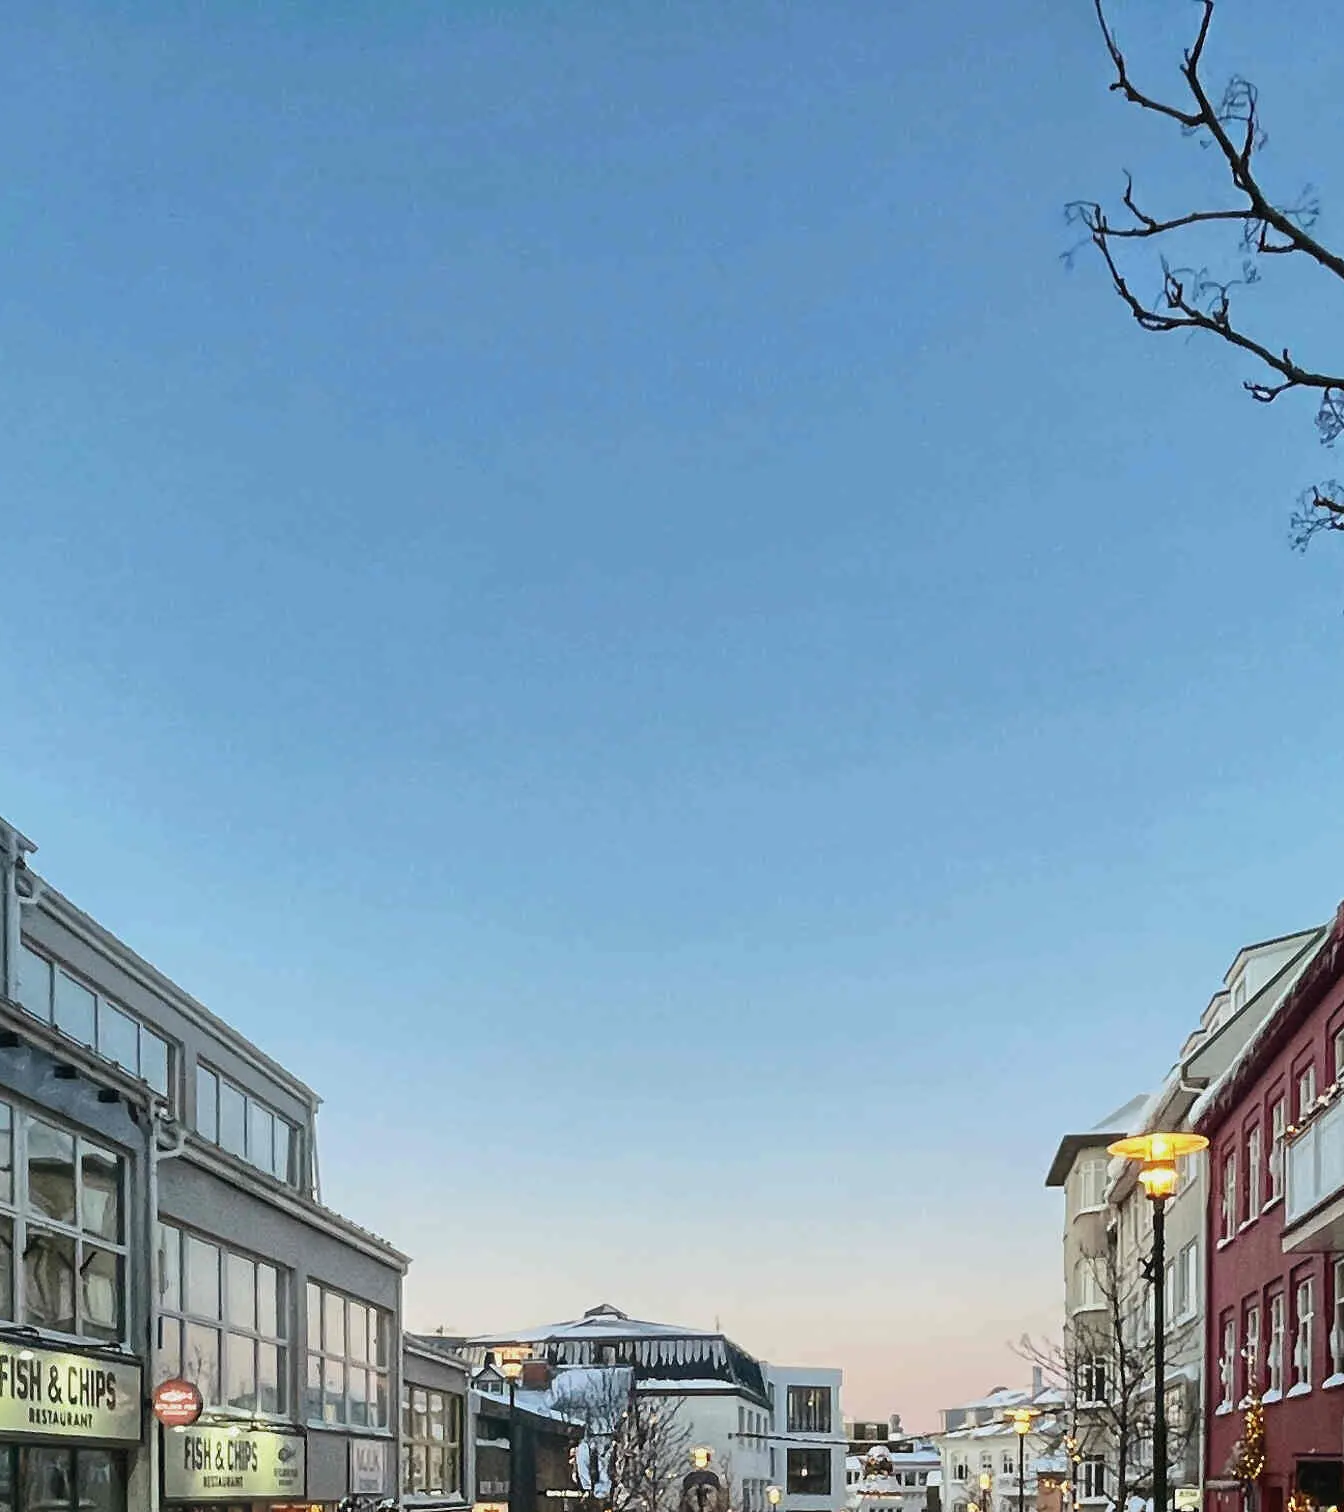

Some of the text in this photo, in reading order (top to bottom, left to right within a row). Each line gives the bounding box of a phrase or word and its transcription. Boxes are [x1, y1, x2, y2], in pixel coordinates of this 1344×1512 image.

[47, 1364, 63, 1405] &
[67, 1365, 117, 1411] CHIPS
[28, 1407, 94, 1429] RESTAURANT
[183, 1435, 258, 1473] FISH & CHIPS
